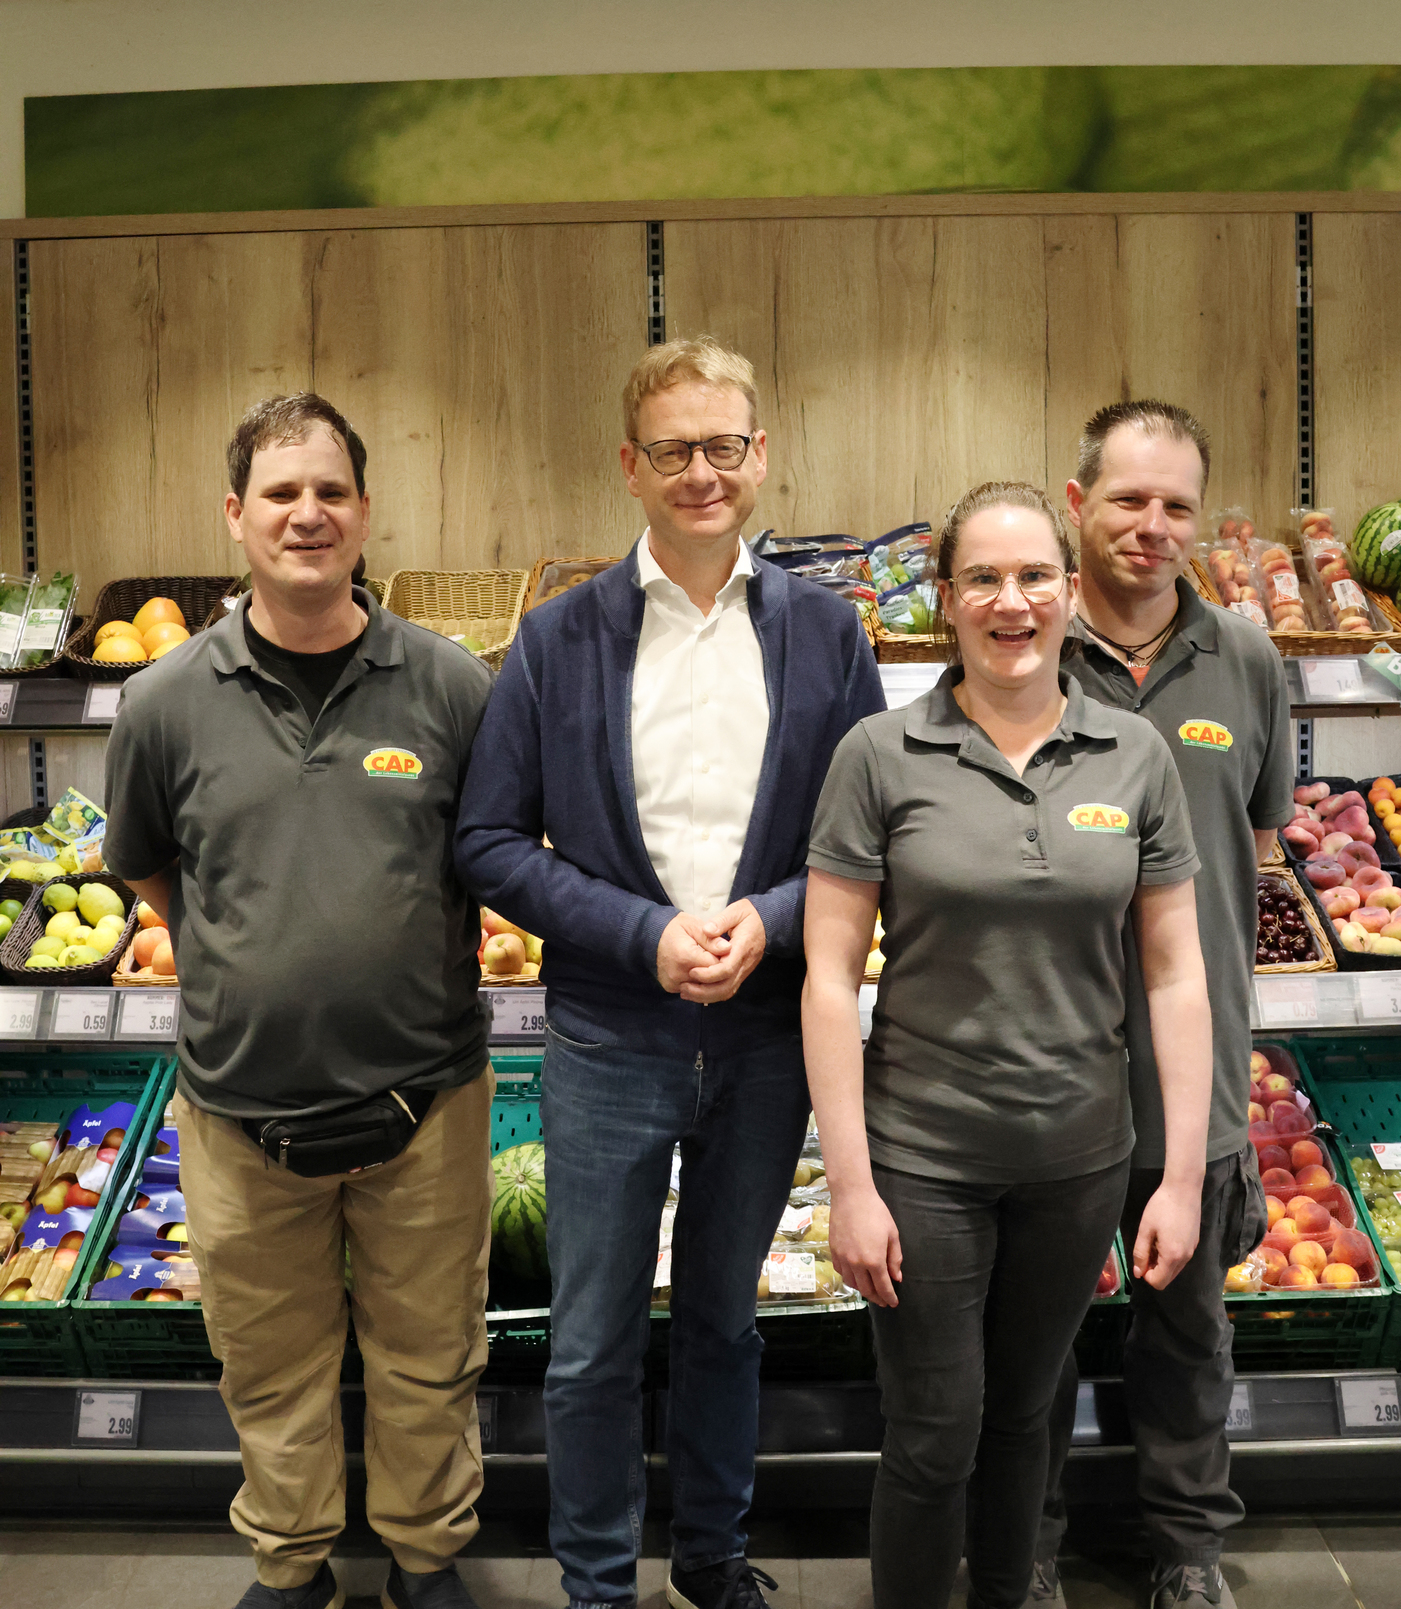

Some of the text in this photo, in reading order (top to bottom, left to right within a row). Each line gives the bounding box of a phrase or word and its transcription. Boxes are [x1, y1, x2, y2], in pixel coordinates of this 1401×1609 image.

[1186, 726, 1226, 744] CAP
[371, 755, 415, 773] CAP
[1076, 810, 1122, 828] CAP
[1292, 1002, 1316, 1017] 0.79
[10, 1014, 32, 1028] 2.99
[83, 1015, 106, 1030] 0.59
[150, 1015, 172, 1030] 3.99
[521, 1015, 544, 1030] 2.99
[82, 1119, 102, 1127] Äpfel
[38, 1220, 59, 1229] Äpfel
[1375, 1404, 1400, 1422] 2.99
[108, 1418, 132, 1434] 2.99
